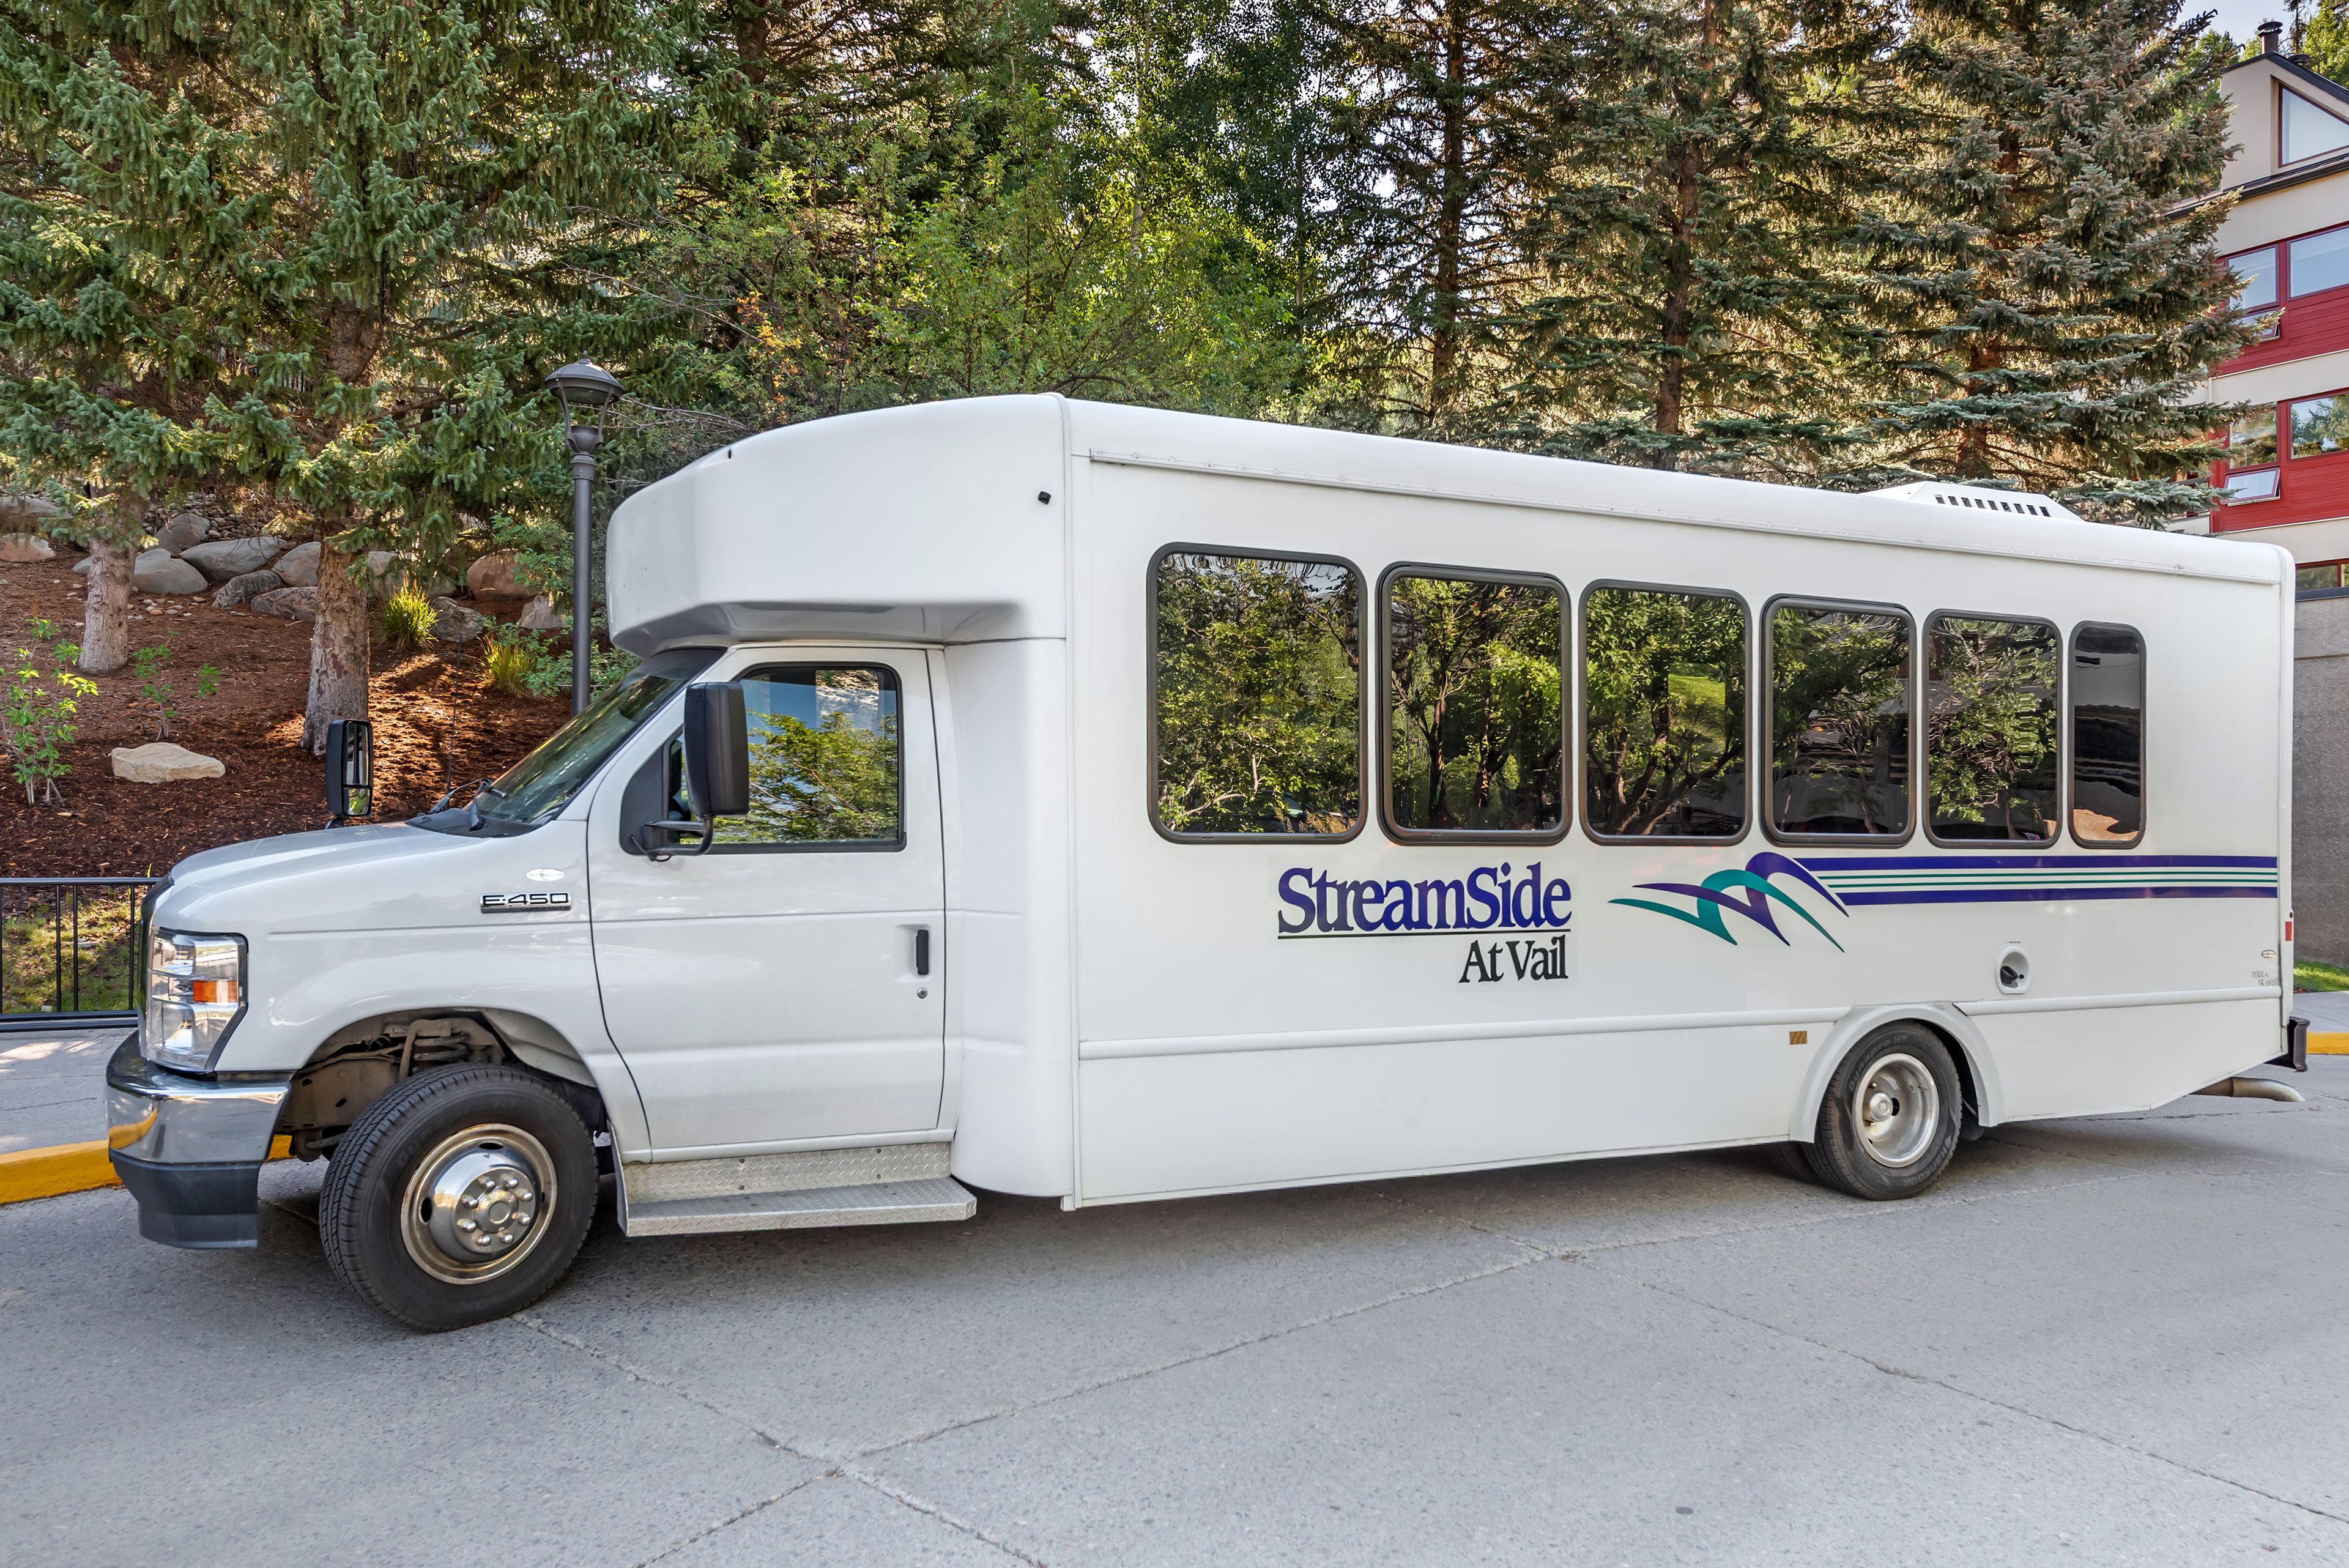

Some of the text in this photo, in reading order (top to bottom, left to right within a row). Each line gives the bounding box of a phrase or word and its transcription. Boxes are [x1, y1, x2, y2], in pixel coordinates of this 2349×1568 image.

[483, 893, 568, 905] E-450
[1278, 861, 1572, 933] StreamSide
[1458, 934, 1568, 983] At Vail
